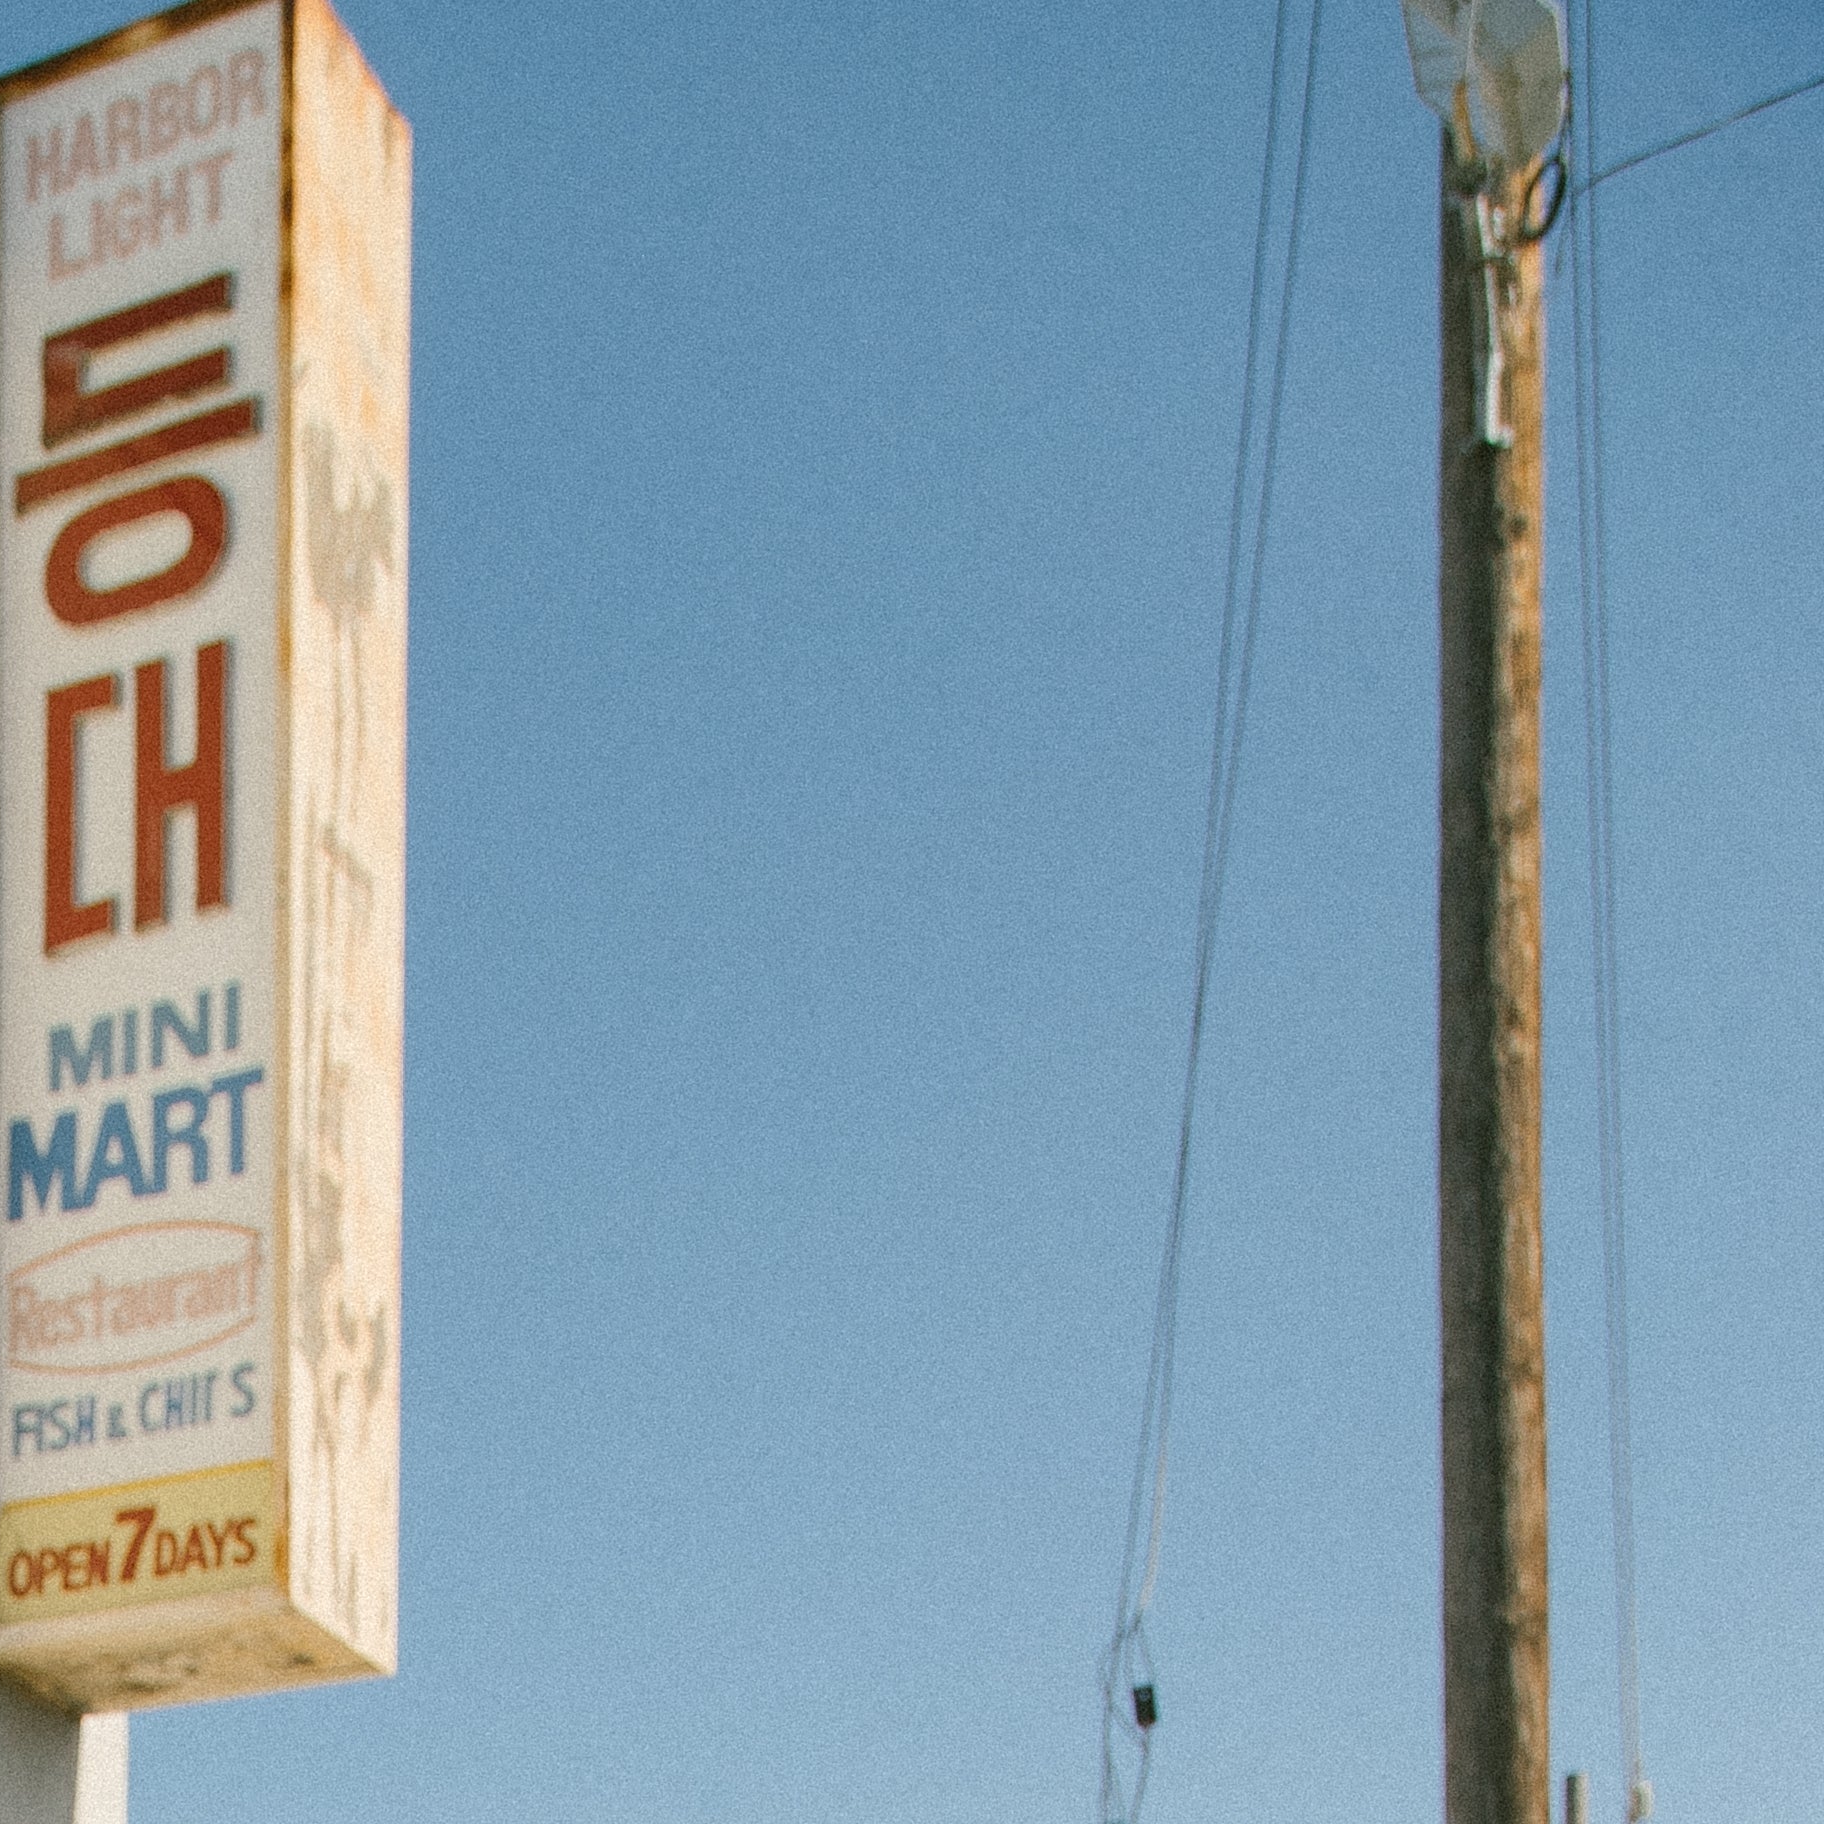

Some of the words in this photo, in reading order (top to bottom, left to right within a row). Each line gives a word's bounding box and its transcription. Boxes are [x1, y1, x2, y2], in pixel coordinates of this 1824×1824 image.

[26, 49, 266, 204] HARBOR
[47, 150, 235, 283] LIGHT
[49, 979, 240, 1091] MINI
[7, 1064, 265, 1221] MART
[8, 1246, 263, 1353] Restaurant
[12, 1393, 97, 1459] FISH
[107, 1402, 128, 1440] &
[7, 1538, 110, 1598] OPEN
[114, 1506, 157, 1582] 7
[153, 1517, 257, 1579] DAYS
